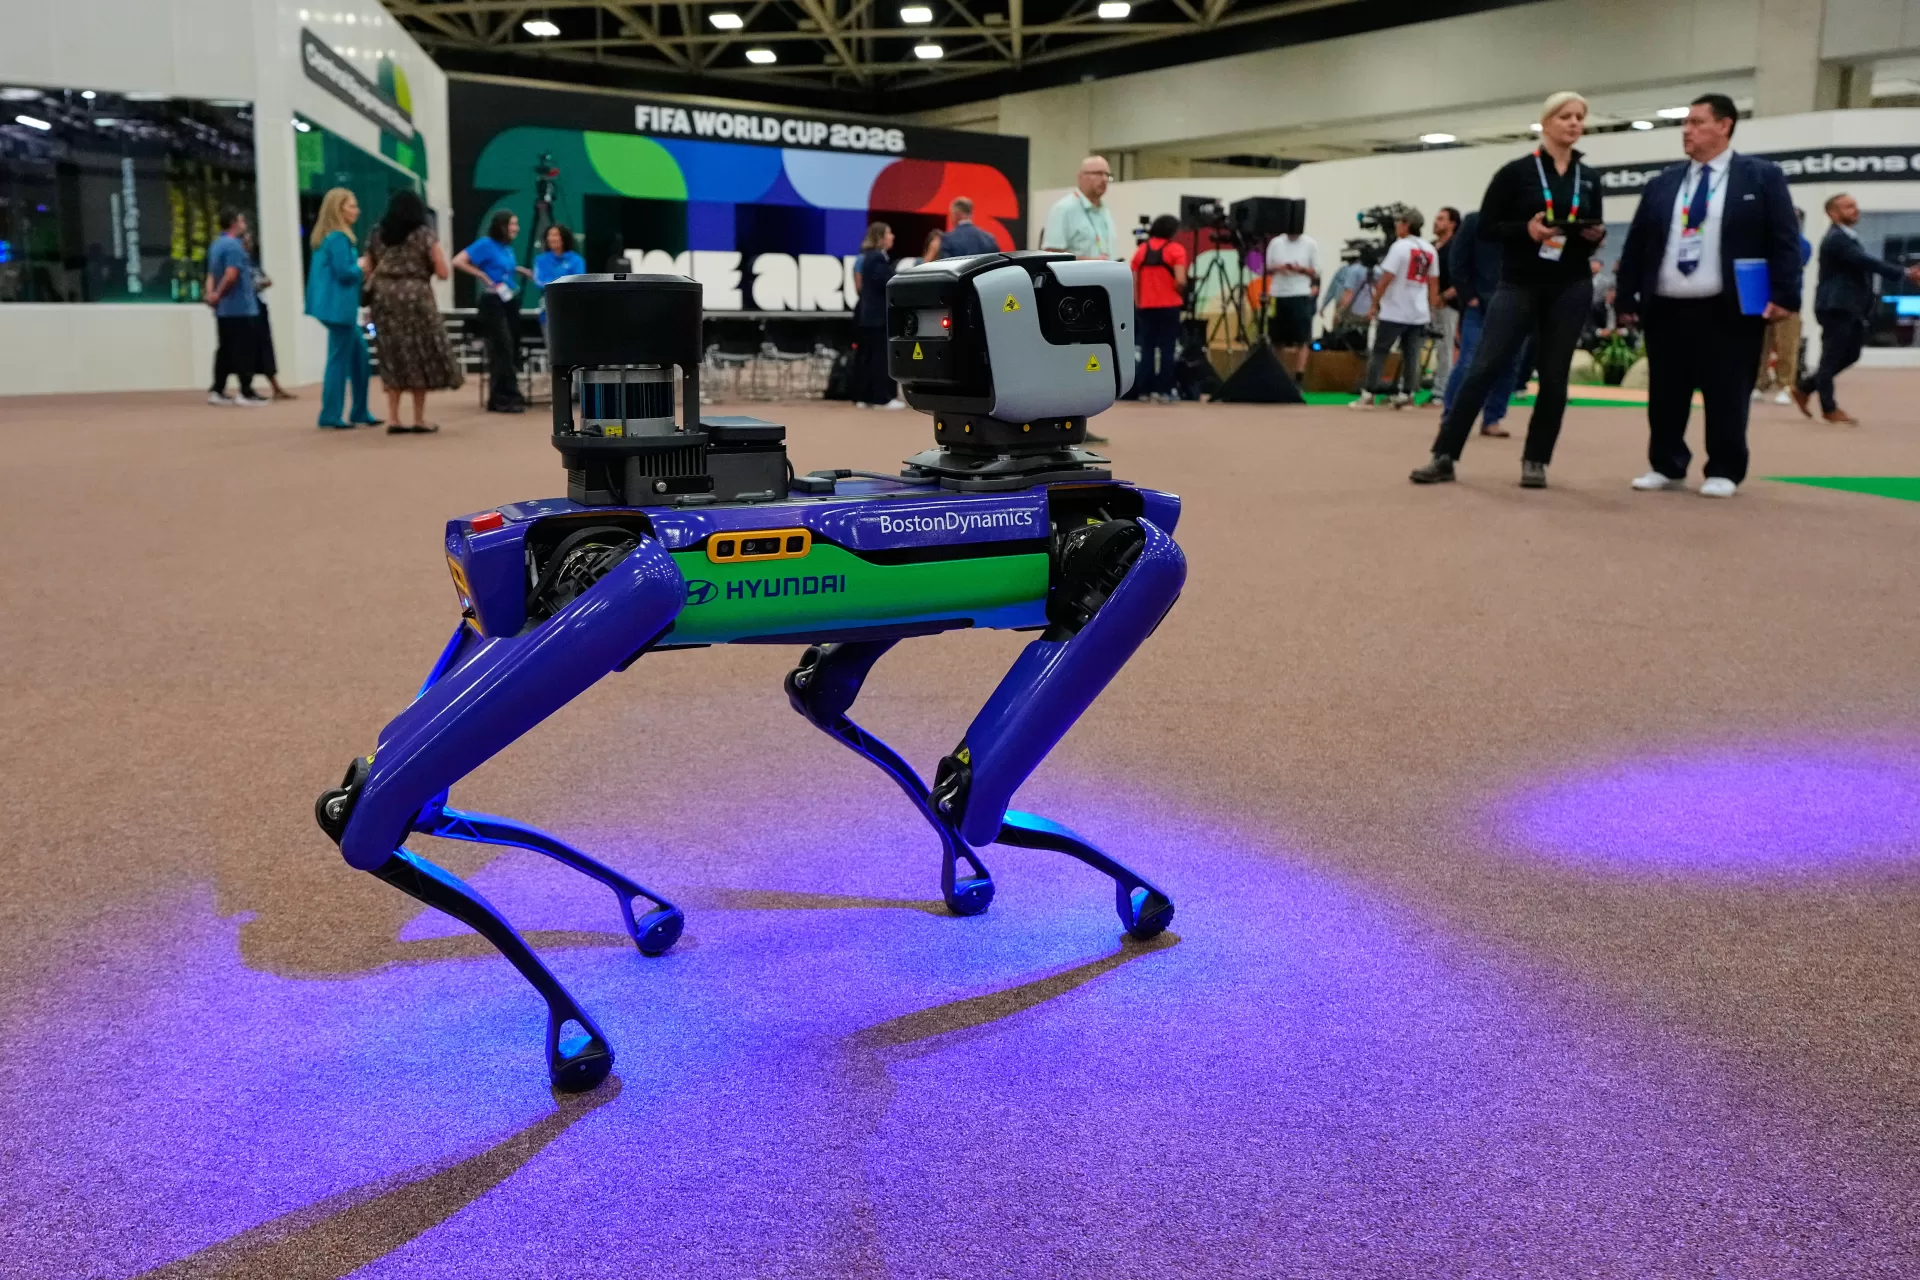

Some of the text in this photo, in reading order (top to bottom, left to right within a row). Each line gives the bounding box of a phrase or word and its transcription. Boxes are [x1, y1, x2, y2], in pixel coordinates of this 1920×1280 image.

[634, 105, 905, 152] FIFA WORLD CUP 2026
[880, 511, 1033, 534] BostonDynamics
[726, 574, 846, 600] HYUNDAI
